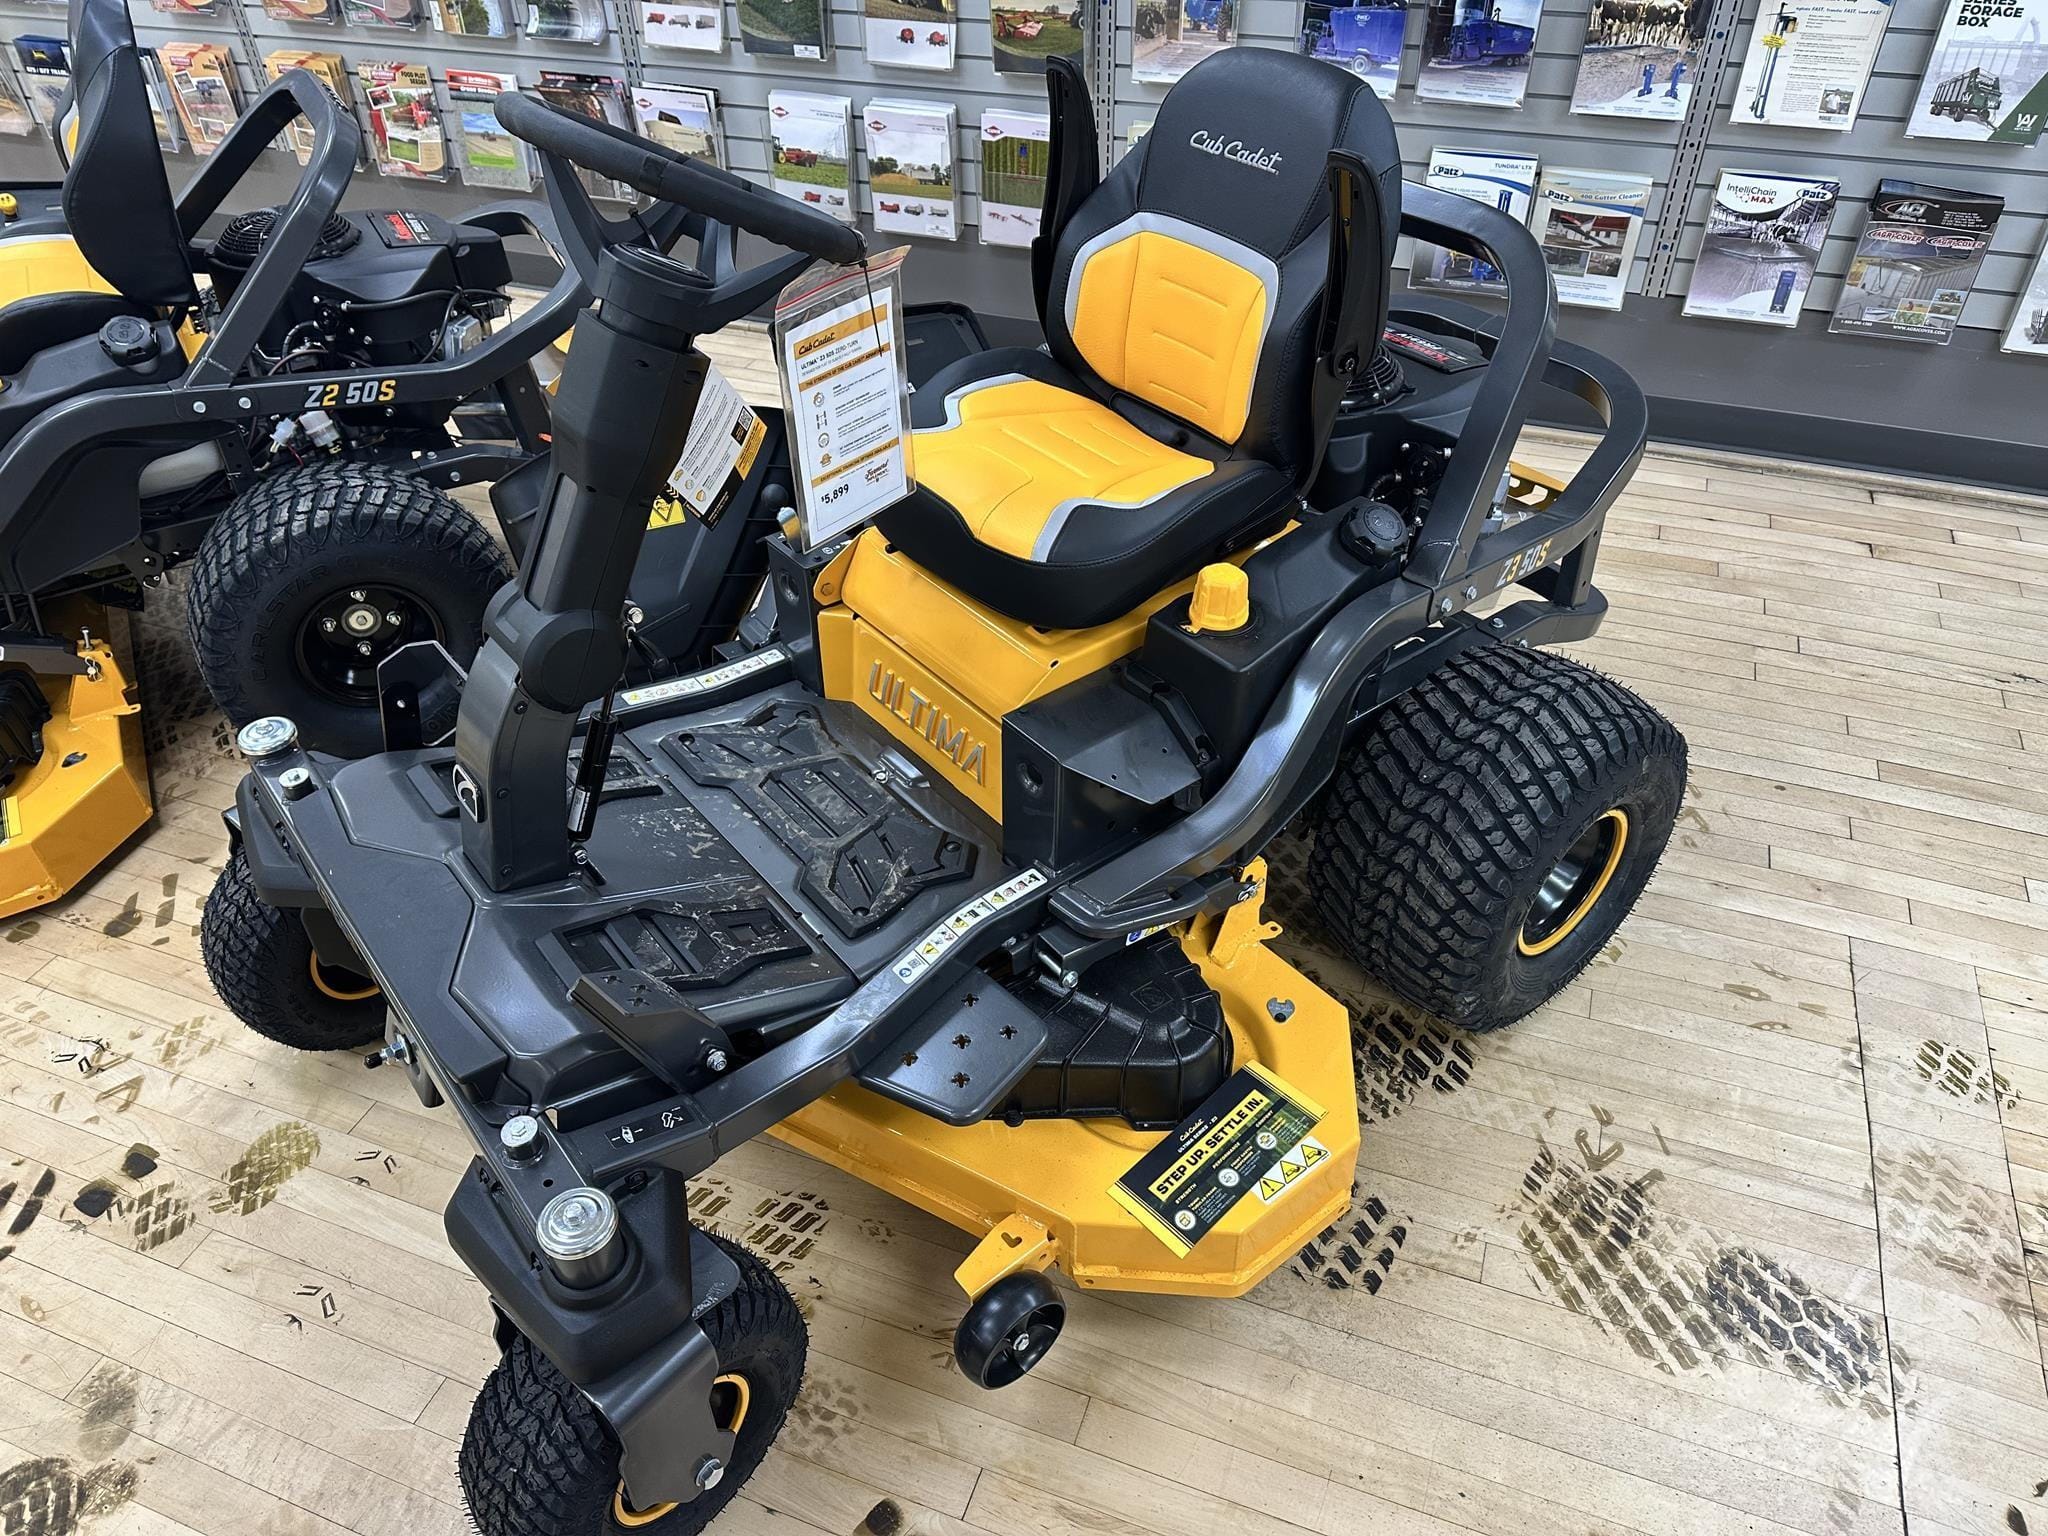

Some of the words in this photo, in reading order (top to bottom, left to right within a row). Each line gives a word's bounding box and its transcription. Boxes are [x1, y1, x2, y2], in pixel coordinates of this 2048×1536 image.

[1957, 16, 1990, 28] BOX
[1960, 6, 2024, 18] FORAGE
[1190, 130, 1225, 155] Cub
[1224, 141, 1282, 173] Cadet
[1437, 165, 1459, 176] Patz
[1547, 189, 1571, 202] Patz
[1618, 192, 1644, 200] Cleaner
[1726, 183, 1777, 196] IntelliChain
[1751, 195, 1776, 204] MAX
[1802, 189, 1828, 200] Patz
[799, 341, 813, 355] Cub
[813, 331, 835, 348] Cadet
[304, 384, 339, 408] Z2
[345, 379, 396, 404] 50S
[821, 484, 849, 504] $5,899
[1496, 554, 1521, 587] Z3
[1519, 538, 1552, 576] 50S
[869, 659, 986, 787] ULTIMA
[1156, 1164, 1189, 1196] STEP
[1186, 1145, 1209, 1168] UP.
[1205, 1108, 1249, 1150] SETTLE
[1245, 1094, 1264, 1113] IN.
[1212, 1141, 1241, 1170] PERFORMANCE
[1174, 1182, 1198, 1205] STRENGTH
